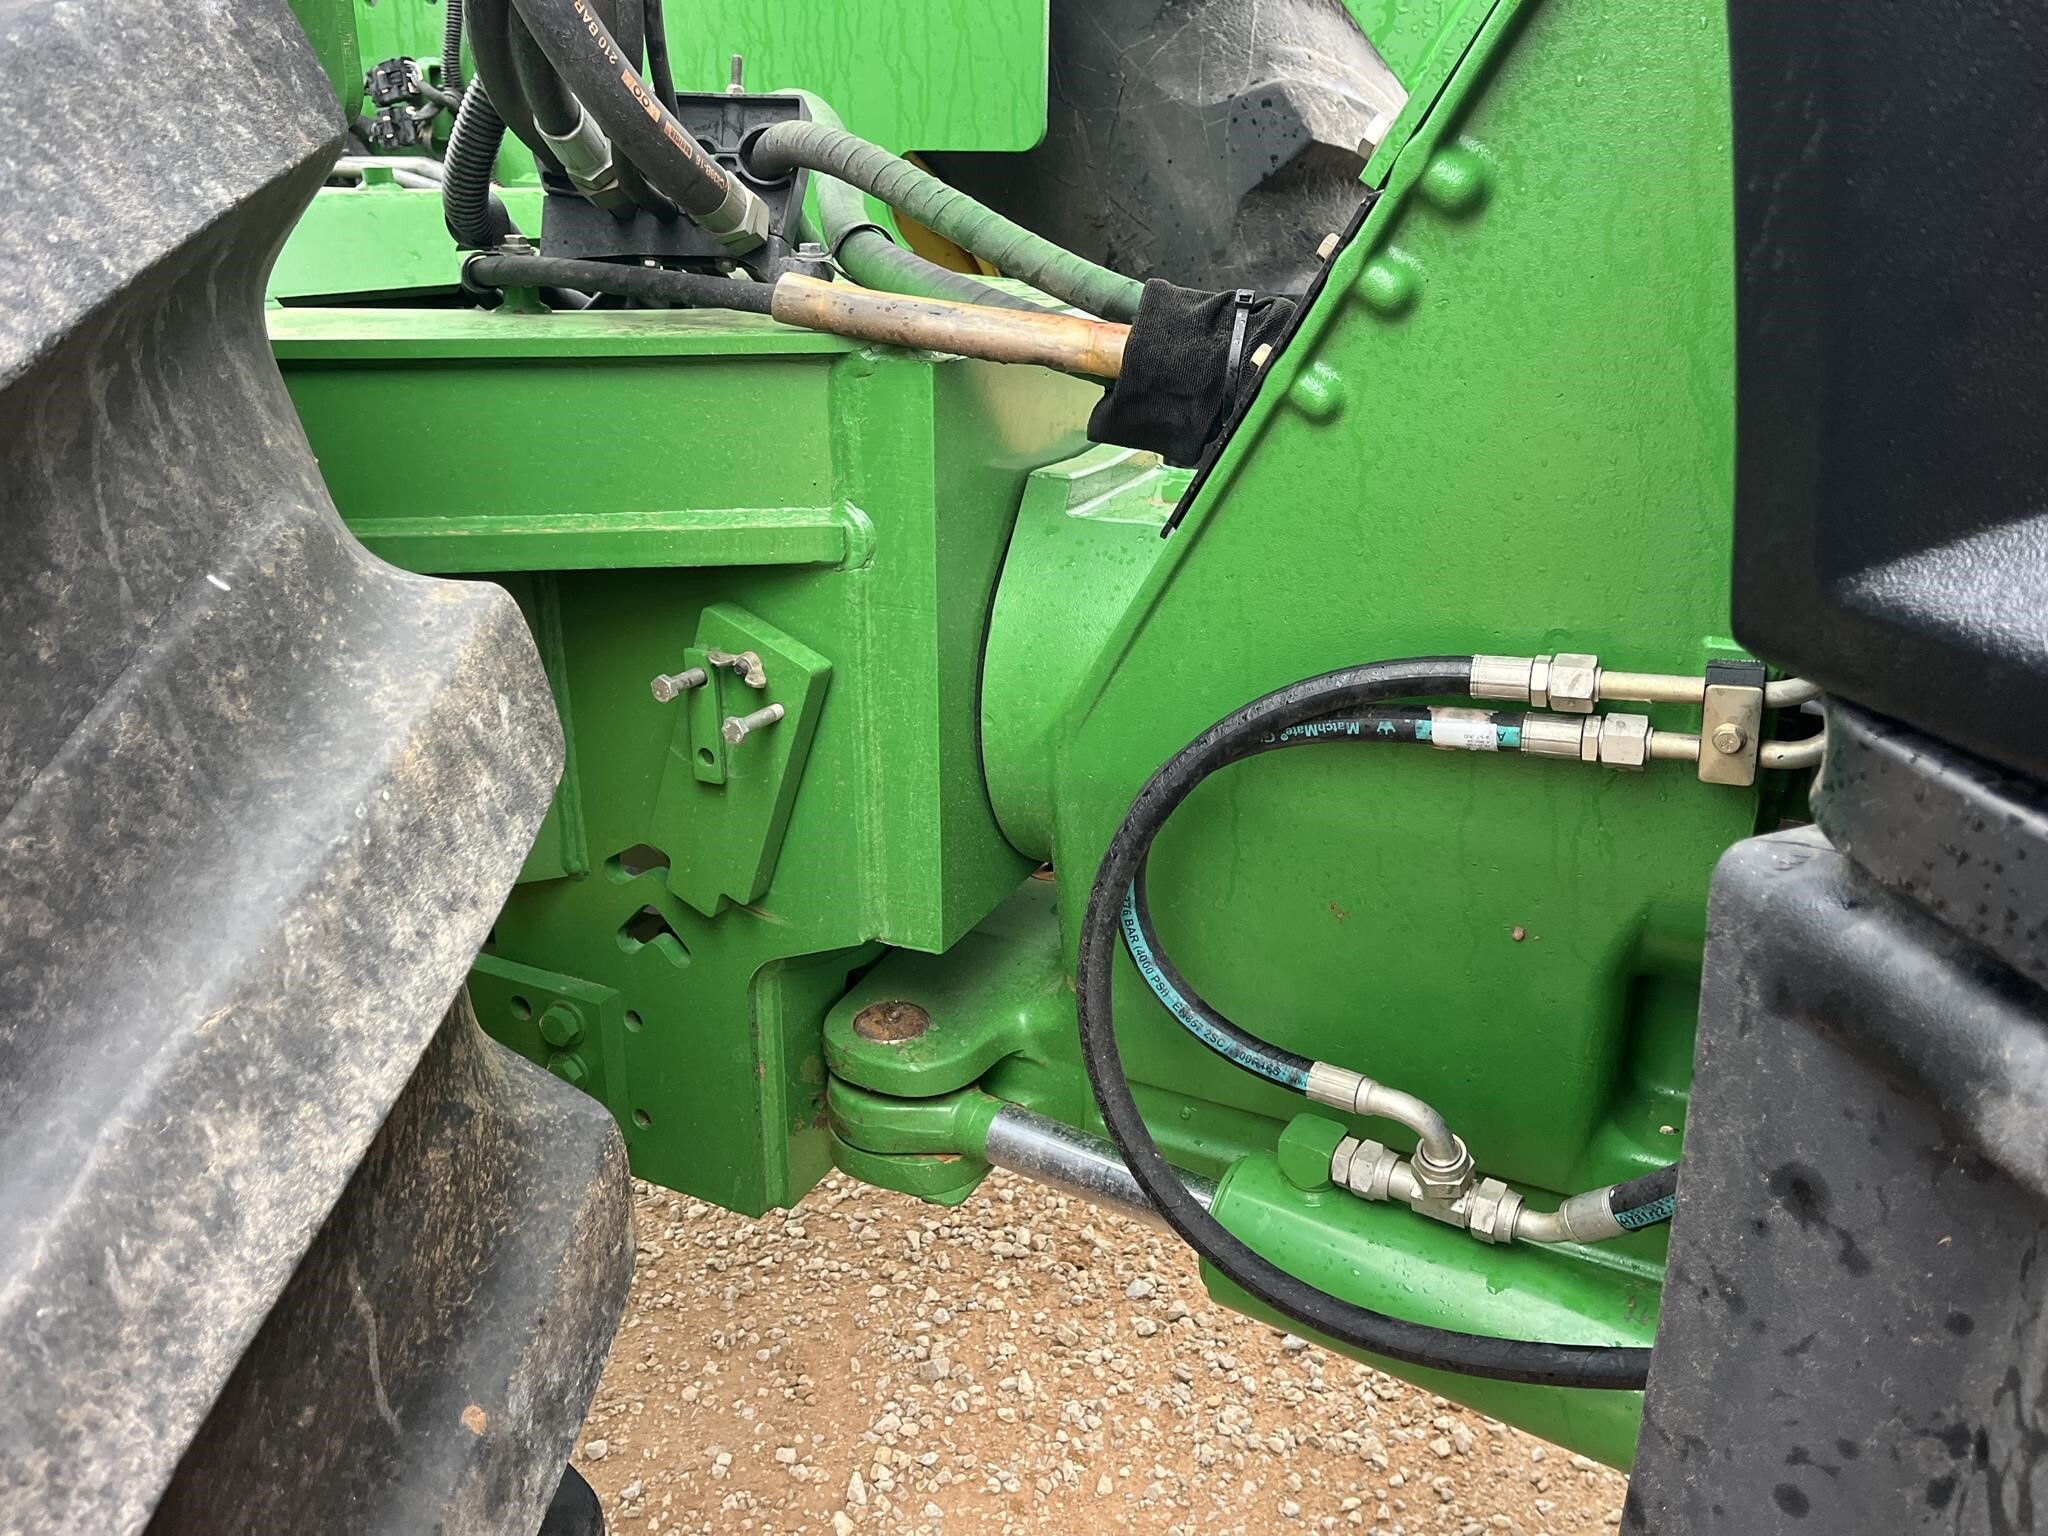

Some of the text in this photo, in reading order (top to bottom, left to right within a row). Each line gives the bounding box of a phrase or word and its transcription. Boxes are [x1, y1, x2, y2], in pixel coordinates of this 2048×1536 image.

[573, 0, 618, 64] 210 BAR
[1124, 920, 1139, 943] BAR
[1133, 945, 1154, 975] (4000
[1151, 976, 1169, 997] PSI)
[1203, 1029, 1225, 1049] 2SC
